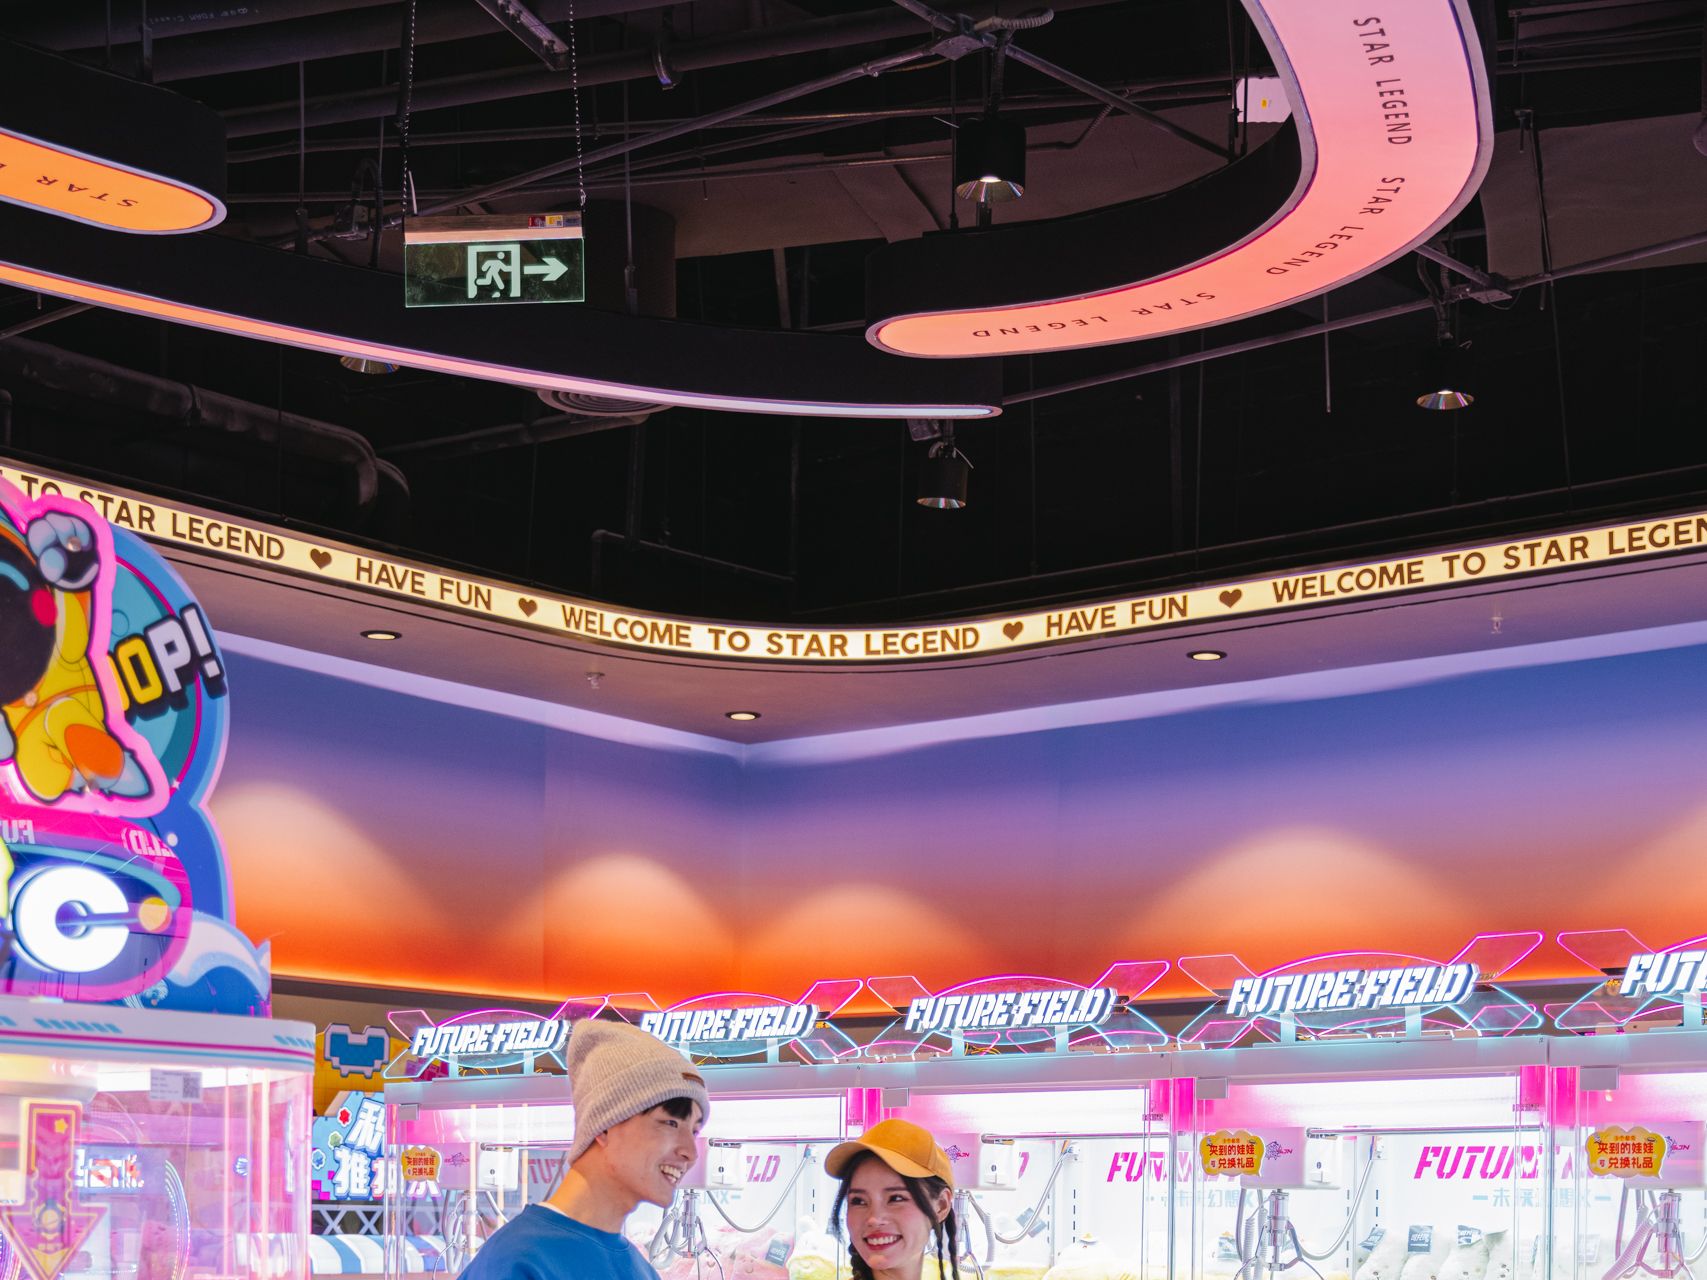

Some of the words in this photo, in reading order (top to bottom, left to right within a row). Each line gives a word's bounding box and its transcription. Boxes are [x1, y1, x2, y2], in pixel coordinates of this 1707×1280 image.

[1353, 17, 1395, 66] STAR
[1376, 78, 1412, 145] LEGEND
[36, 175, 138, 207] STAR
[1359, 177, 1405, 214] STAR
[1266, 225, 1364, 275] LEGEND
[1131, 292, 1216, 316] STAR
[972, 315, 1108, 338] LEGEND
[79, 490, 155, 532] STAR
[172, 513, 285, 561] LEGEND
[1272, 561, 1425, 604] WELCOME
[1442, 551, 1486, 579] TO
[1503, 536, 1589, 570] STAR
[1608, 518, 1707, 556] LEGE
[356, 557, 426, 596] HAVE
[439, 577, 492, 611] FUN
[562, 604, 692, 648] WELCOME
[708, 628, 750, 652] TO
[766, 632, 848, 658] STAR
[865, 626, 980, 657] LEGEND
[1046, 605, 1116, 638] HAVE
[1131, 595, 1188, 625] FUN
[105, 606, 221, 712] OP!
[1226, 970, 1358, 1015] FUTURE
[1357, 964, 1472, 1009] FIELD
[1620, 950, 1707, 994] FUT
[730, 1004, 808, 1040] FIELD
[905, 992, 1016, 1031] FUTURE
[1014, 988, 1106, 1027] FIELD
[412, 1024, 493, 1056] FUTURE
[493, 1020, 560, 1052] FIELD
